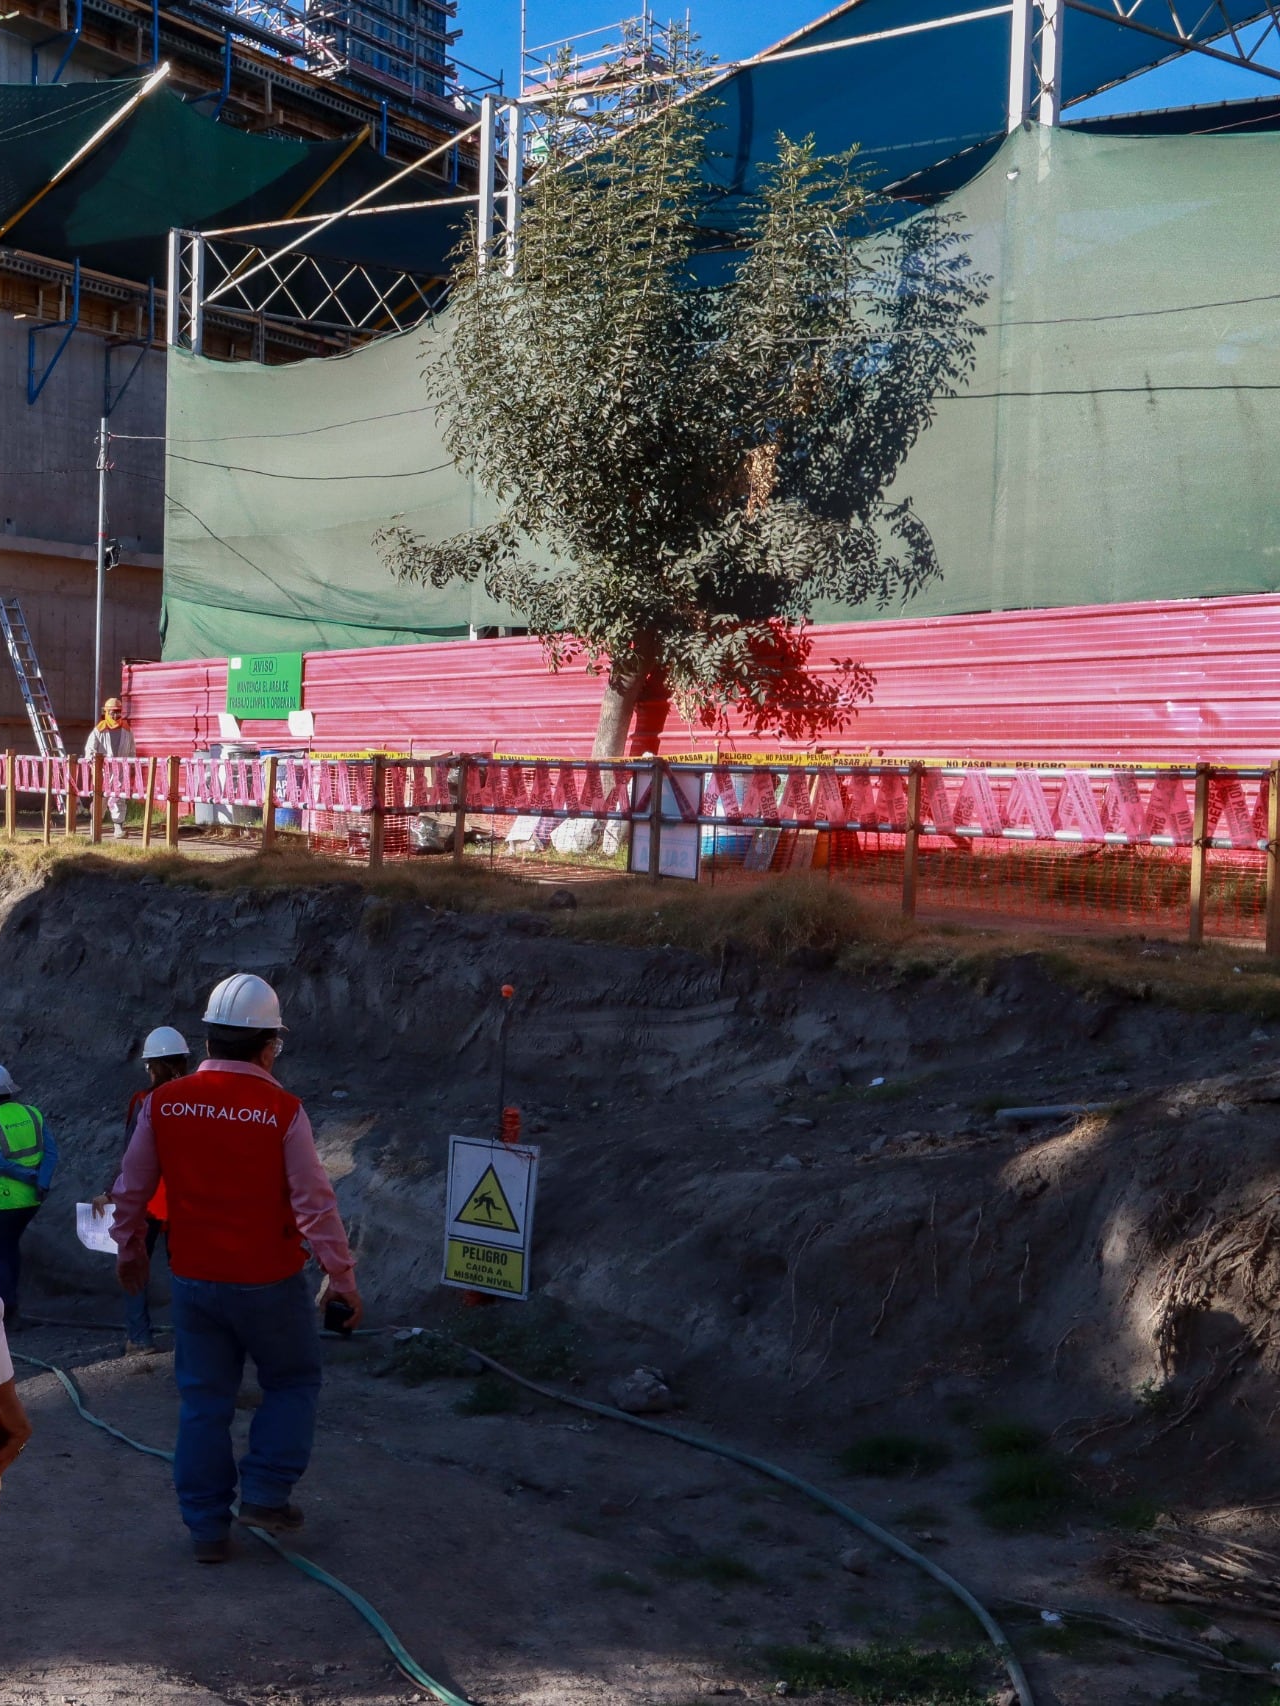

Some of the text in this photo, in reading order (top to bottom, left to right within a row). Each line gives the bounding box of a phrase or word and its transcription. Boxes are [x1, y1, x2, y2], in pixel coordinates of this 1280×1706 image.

[252, 660, 274, 673] AVISO
[679, 754, 703, 762] PASAR
[720, 752, 752, 760] PELIGRO
[833, 758, 860, 766] PASAR
[946, 760, 959, 768] NO
[161, 1102, 278, 1128] CONTRALORÍA
[462, 1245, 508, 1266] PELIGRO
[466, 1262, 503, 1277] CAIDA A
[453, 1270, 514, 1289] MISMO NIVEL
